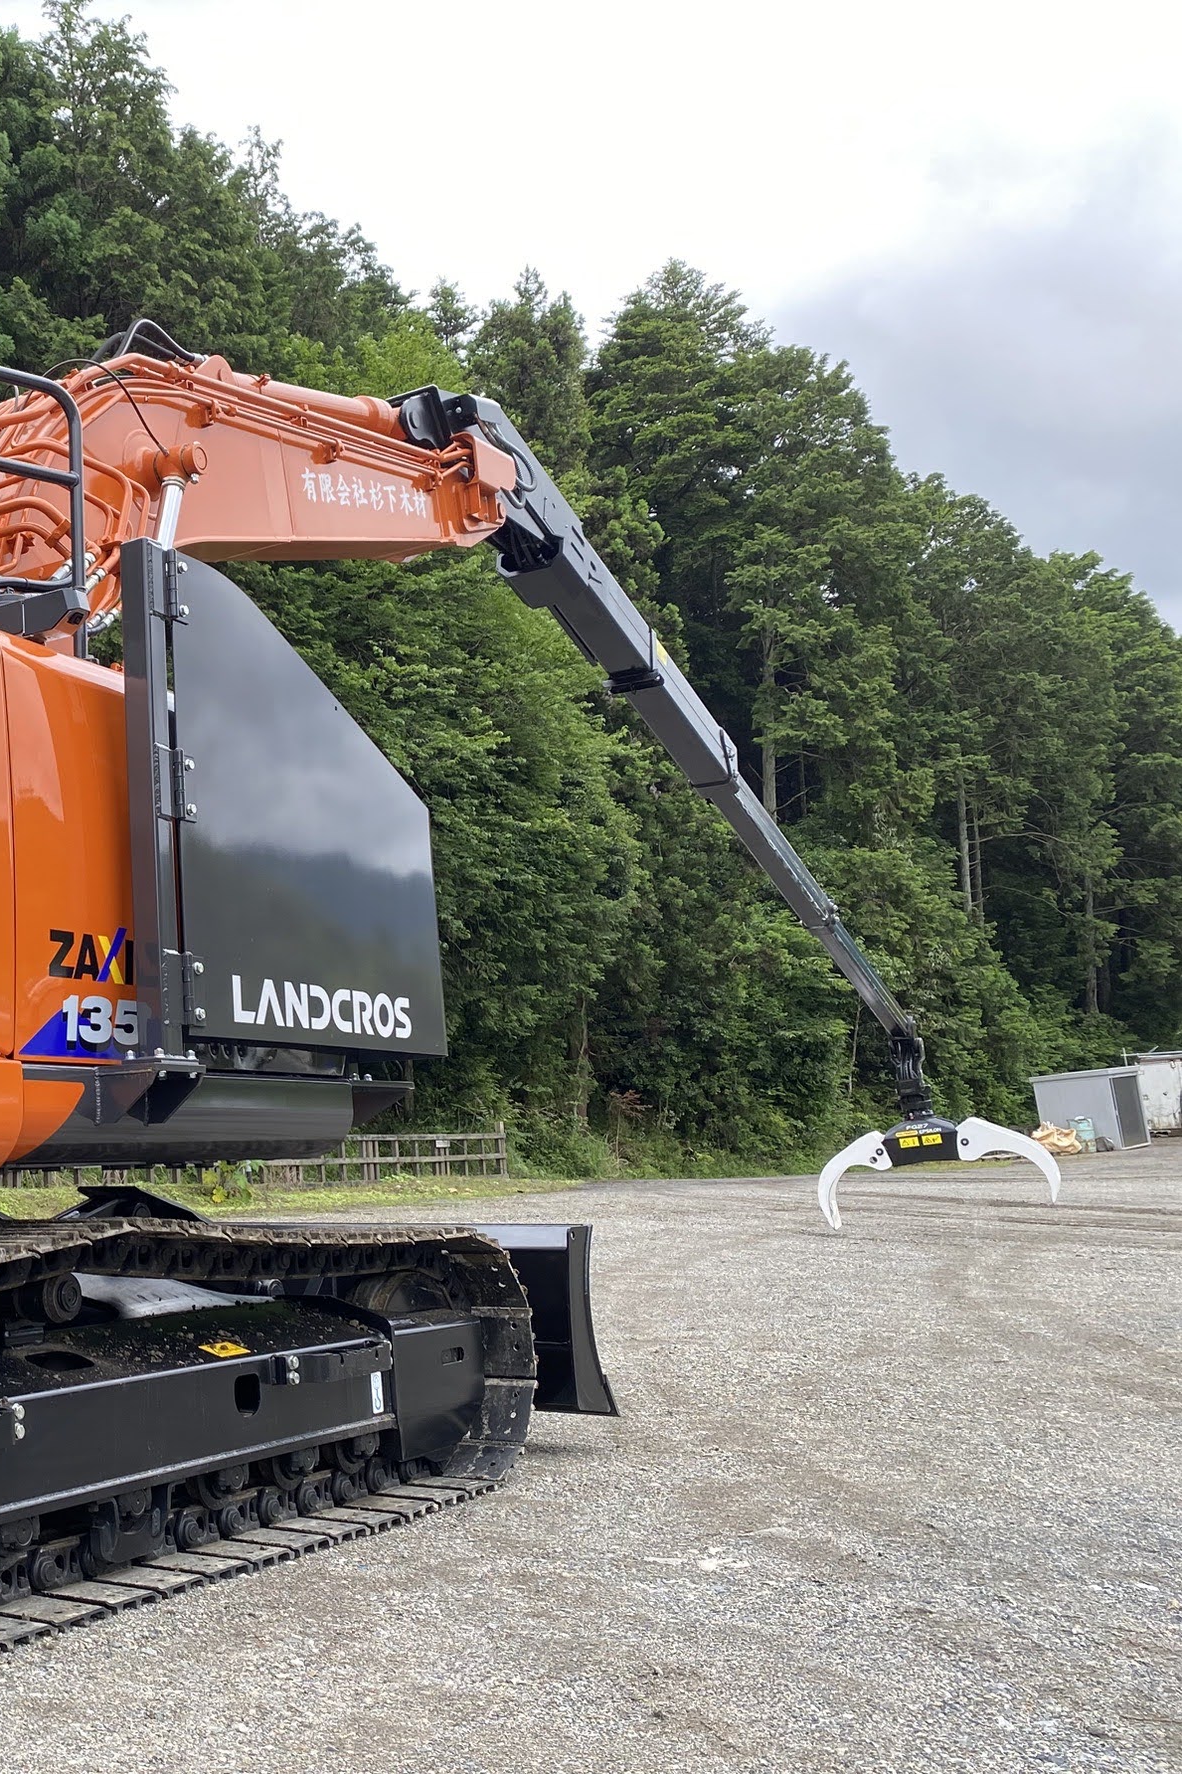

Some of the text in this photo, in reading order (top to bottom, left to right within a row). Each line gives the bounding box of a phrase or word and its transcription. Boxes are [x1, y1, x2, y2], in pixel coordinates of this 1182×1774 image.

[301, 466, 427, 519] 有限会社杉下木材
[231, 974, 413, 1039] LANDCROS
